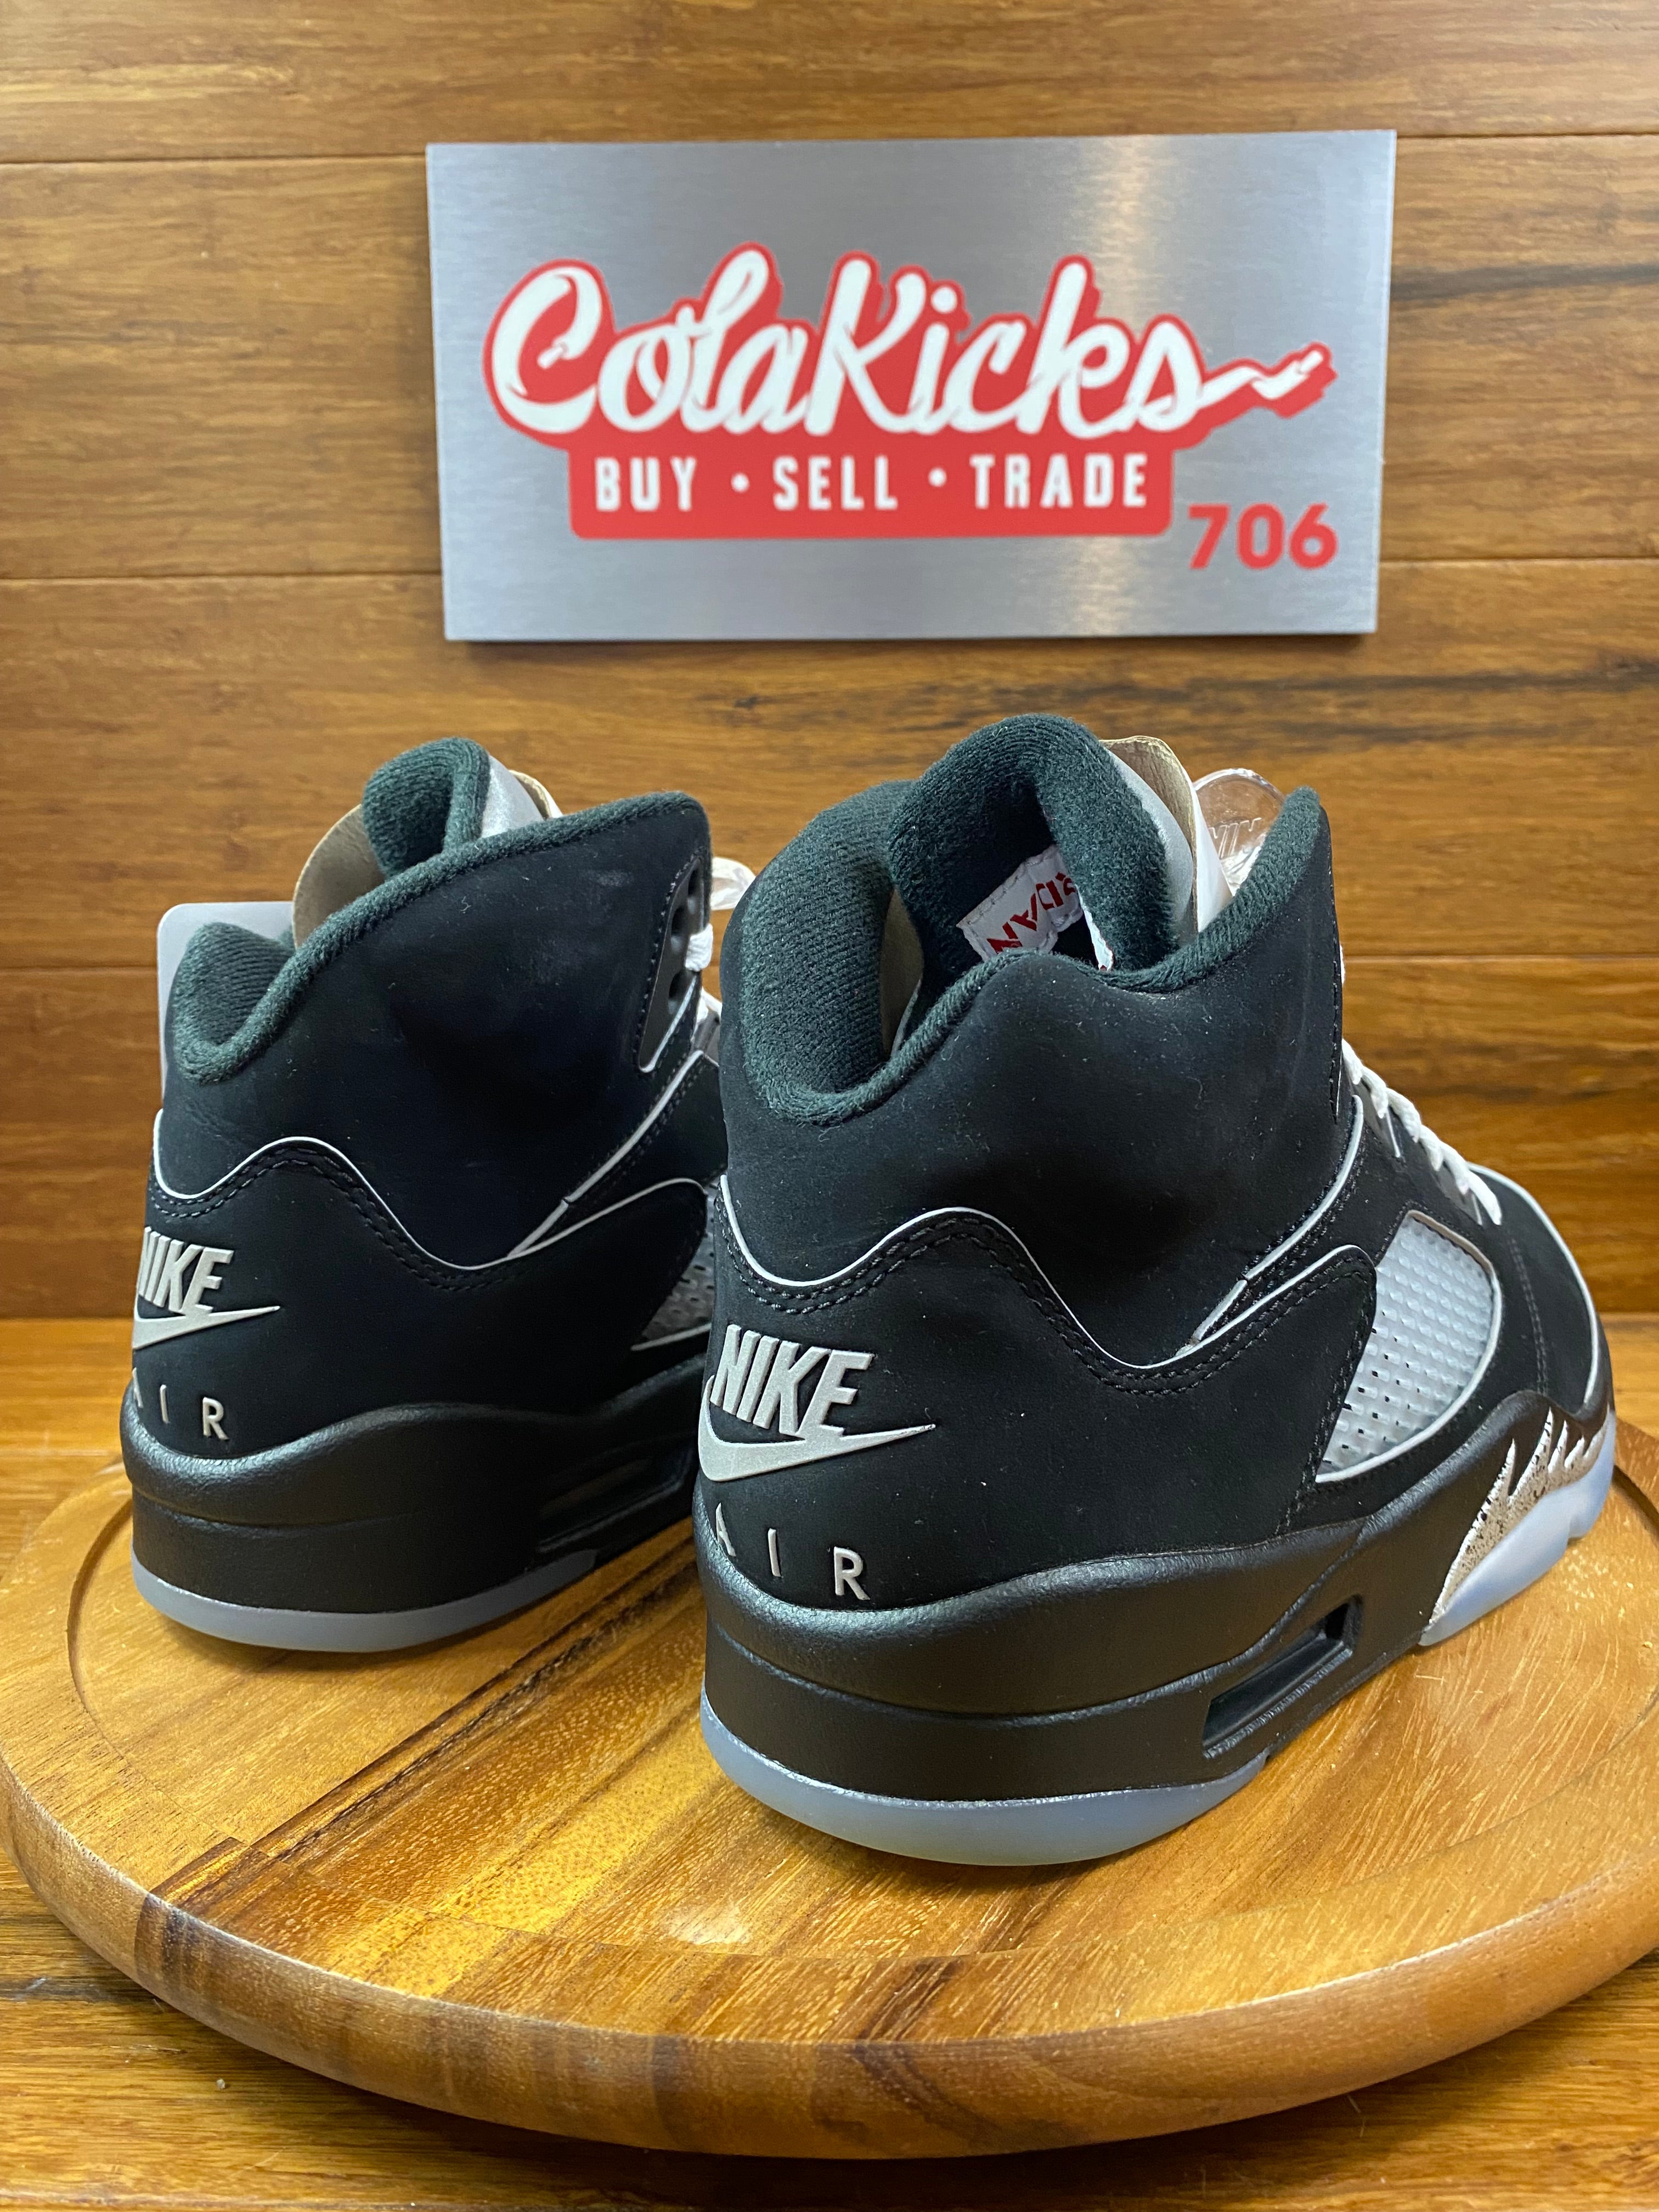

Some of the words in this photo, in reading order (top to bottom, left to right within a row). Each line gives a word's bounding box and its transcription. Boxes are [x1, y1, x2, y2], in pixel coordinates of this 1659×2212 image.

[492, 249, 1324, 439] ColaKicks
[595, 456, 696, 512] BUY
[772, 454, 899, 511] SELL
[969, 453, 1148, 509] TRADE
[1187, 503, 1339, 569] 706
[137, 1226, 235, 1315] NIKE
[709, 1323, 876, 1440] NIKE
